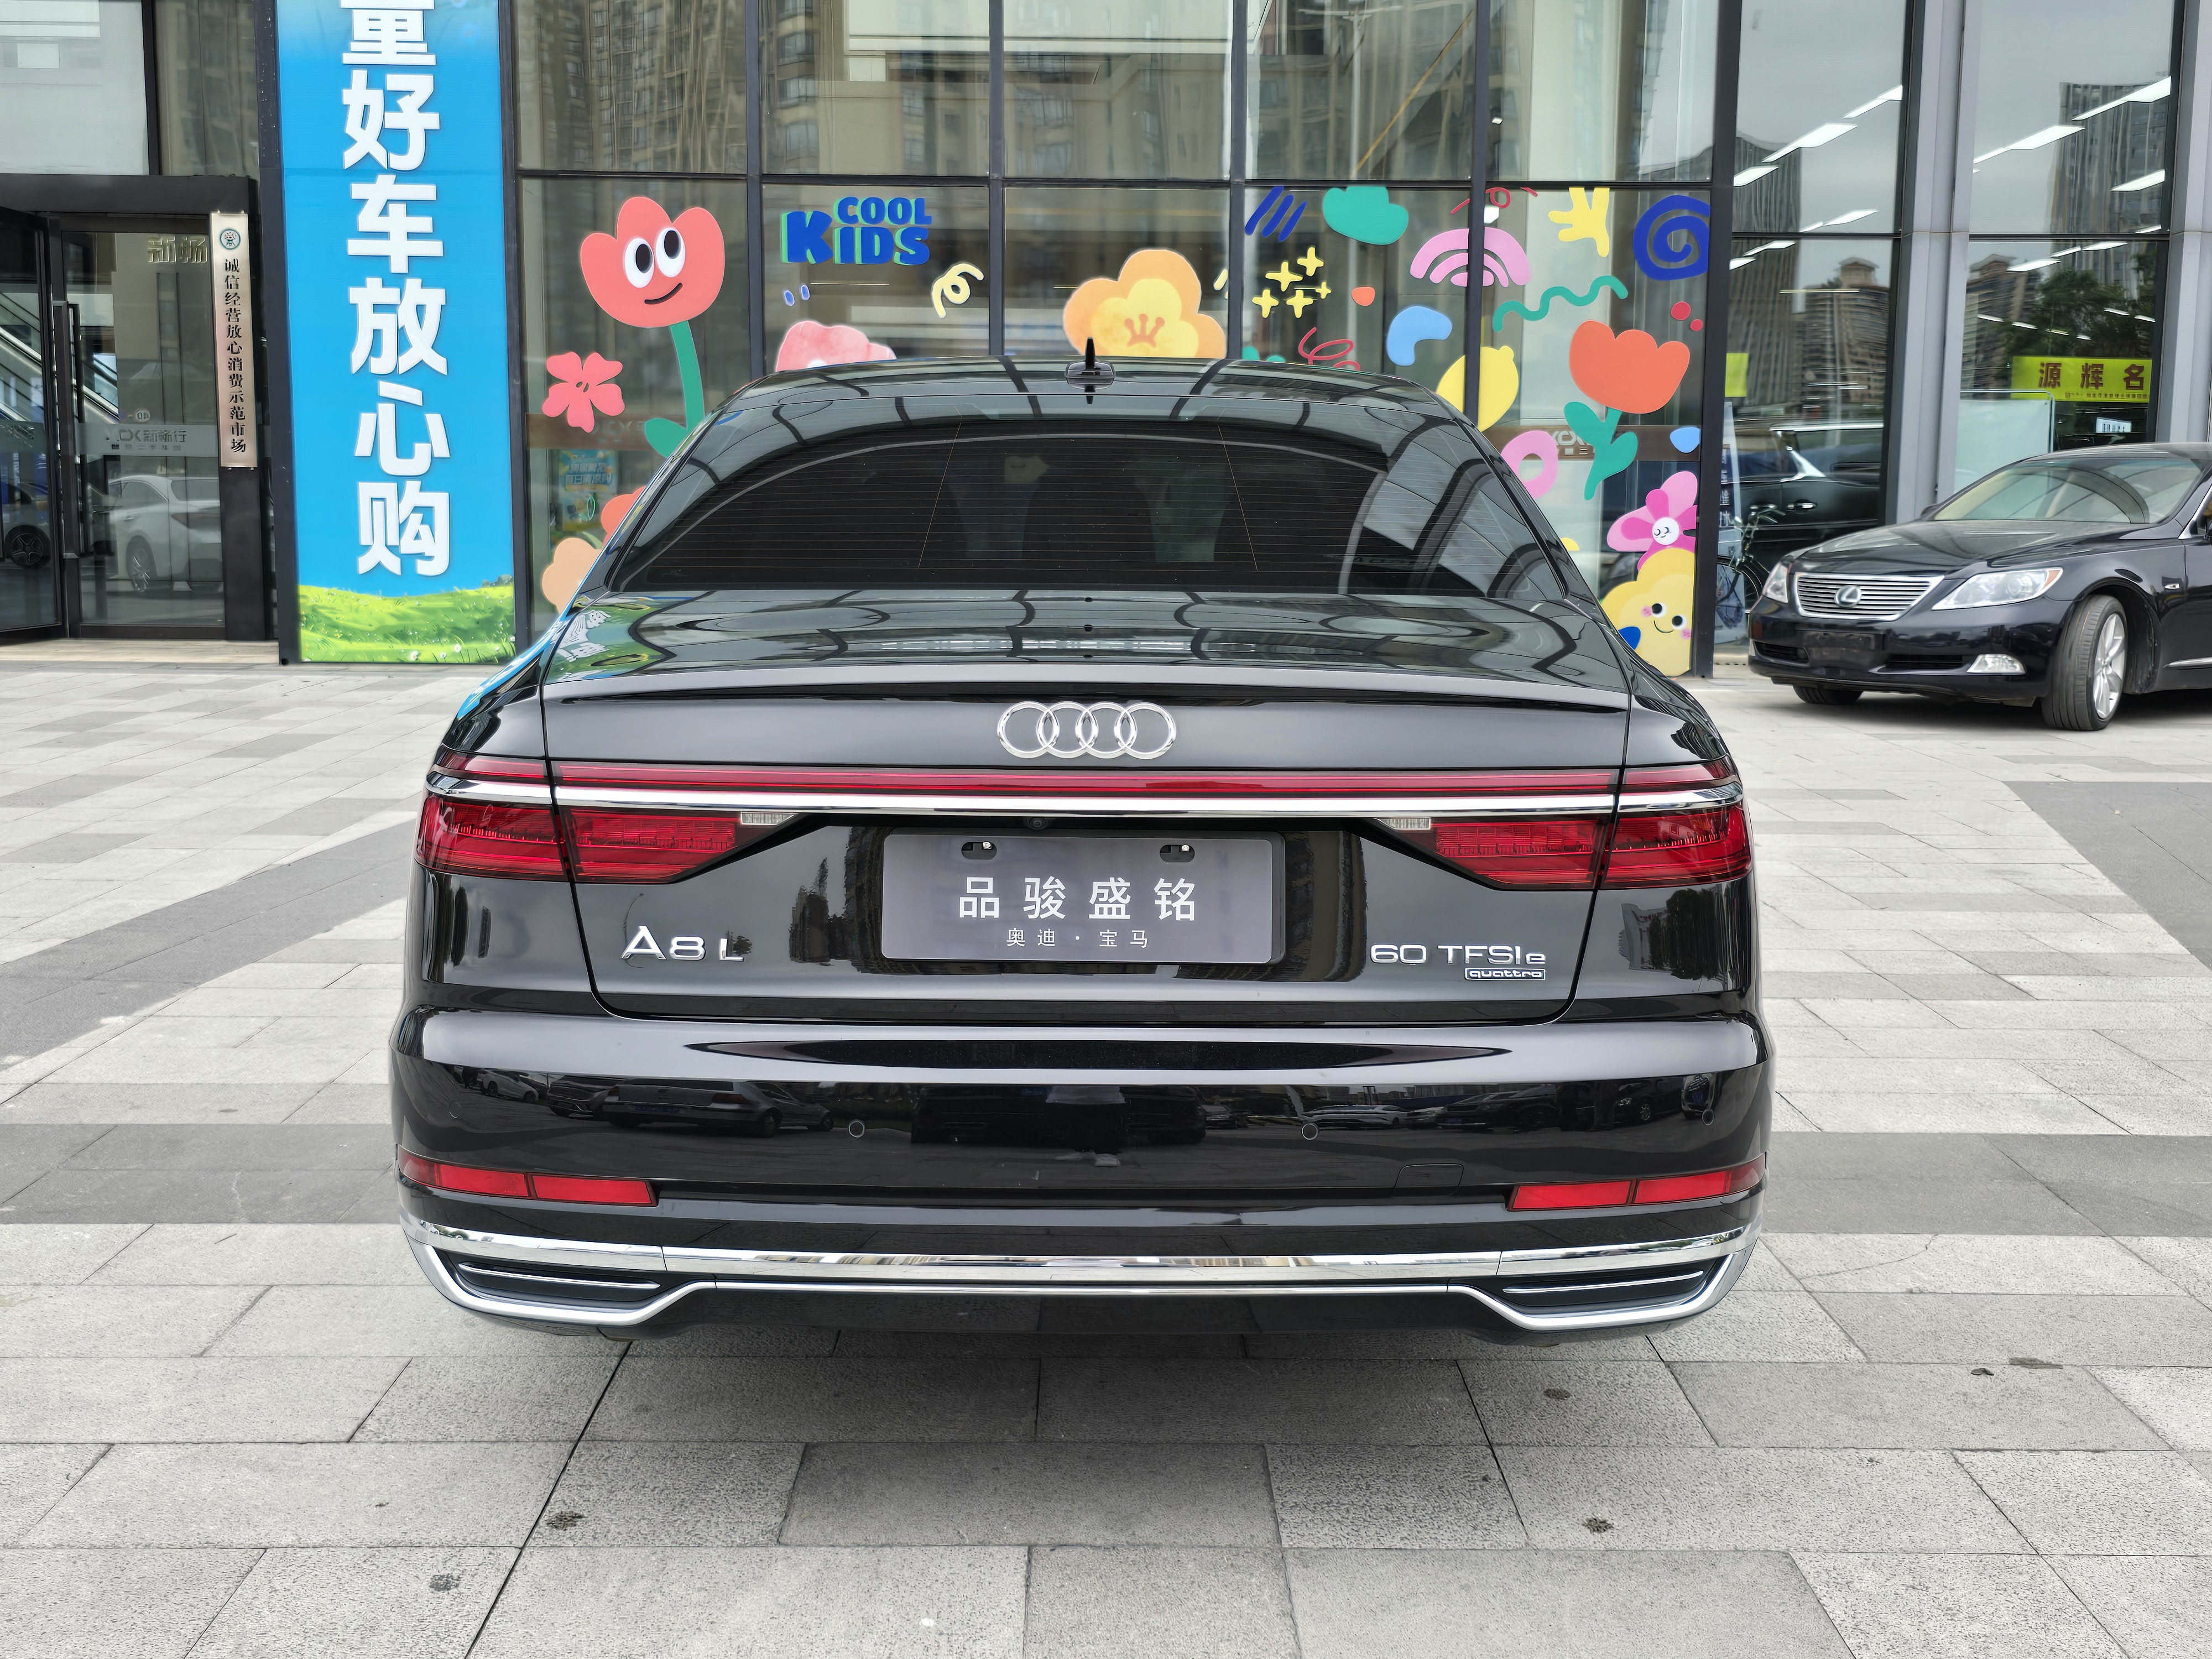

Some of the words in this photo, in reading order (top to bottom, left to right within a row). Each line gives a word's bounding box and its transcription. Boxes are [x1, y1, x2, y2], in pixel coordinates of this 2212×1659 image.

[832, 197, 932, 226] COOL
[225, 258, 246, 452] 诚信经营放心消费示范市场
[2038, 362, 2145, 390] 源辉名
[959, 876, 1196, 921] 品骏盛铭
[620, 925, 706, 961] A8
[719, 938, 745, 962] L
[1006, 927, 1149, 948] 奥迪·宝马
[1370, 944, 1427, 965] 60
[1468, 970, 1543, 979] quattro
